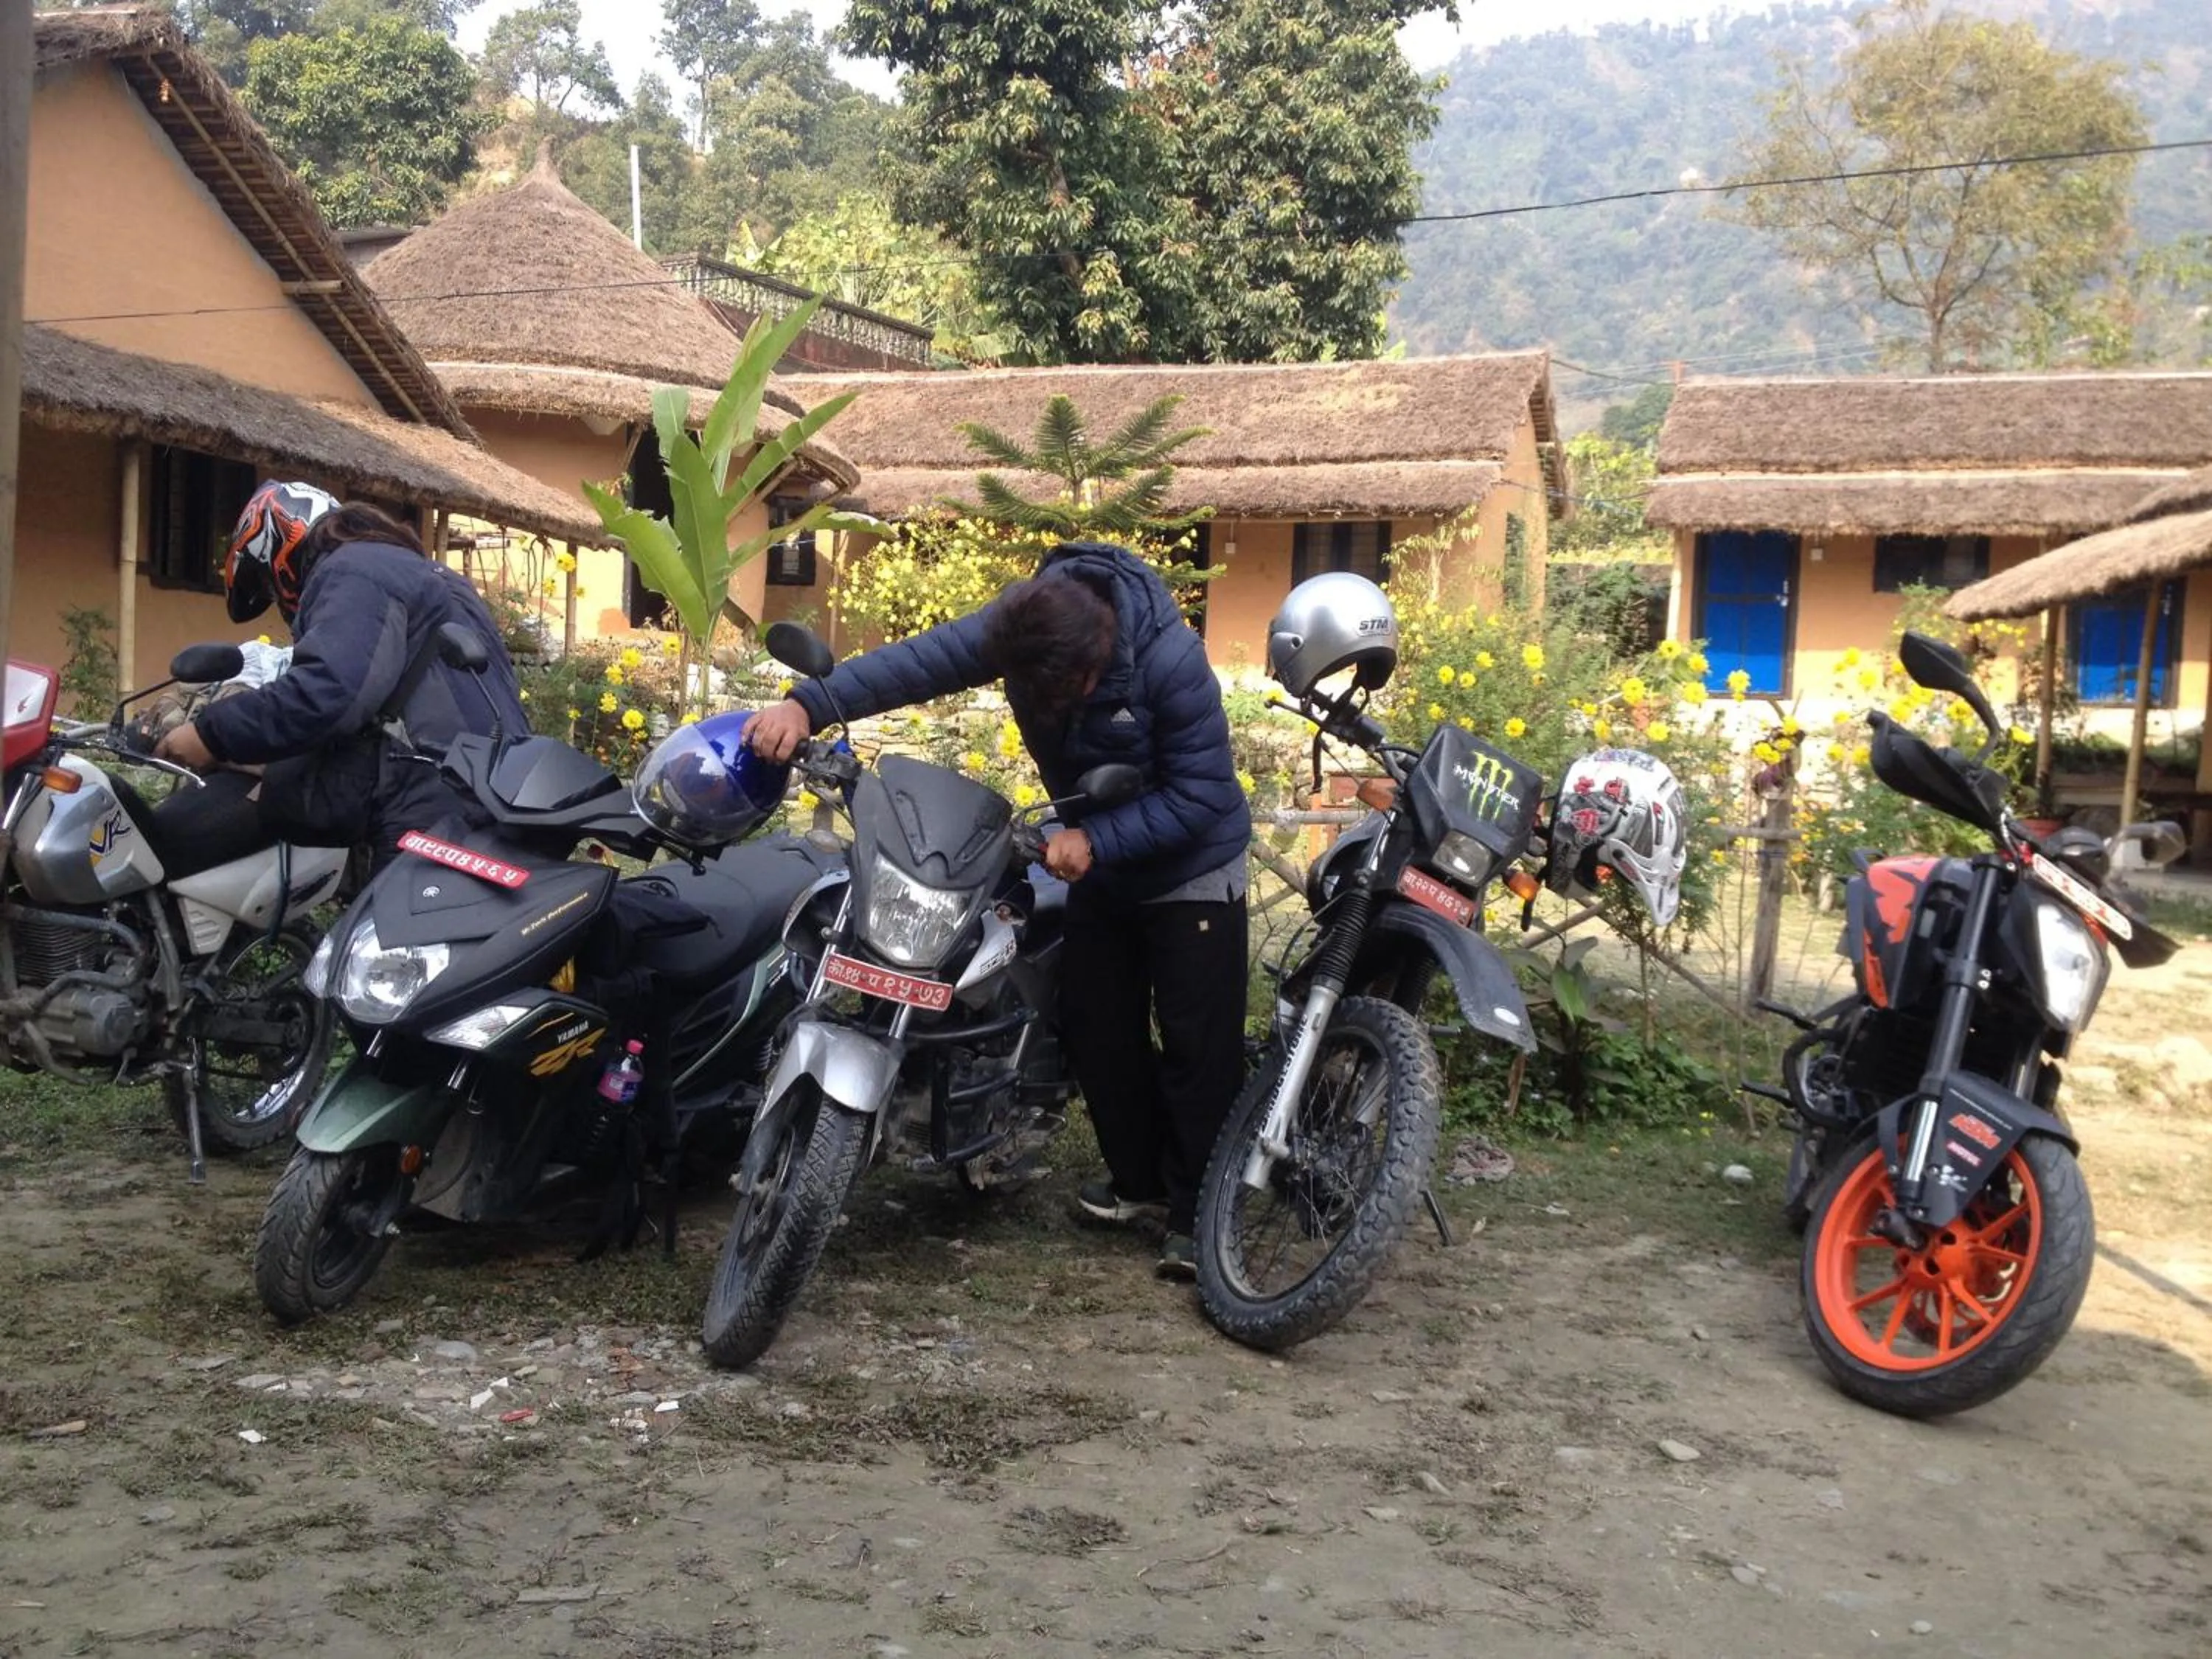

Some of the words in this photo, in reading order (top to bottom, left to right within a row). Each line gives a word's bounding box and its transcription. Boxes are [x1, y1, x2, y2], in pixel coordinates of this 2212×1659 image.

[1359, 619, 1388, 630] STM
[1454, 765, 1519, 810] MONSTER
[557, 1020, 589, 1044] YAMAHA
